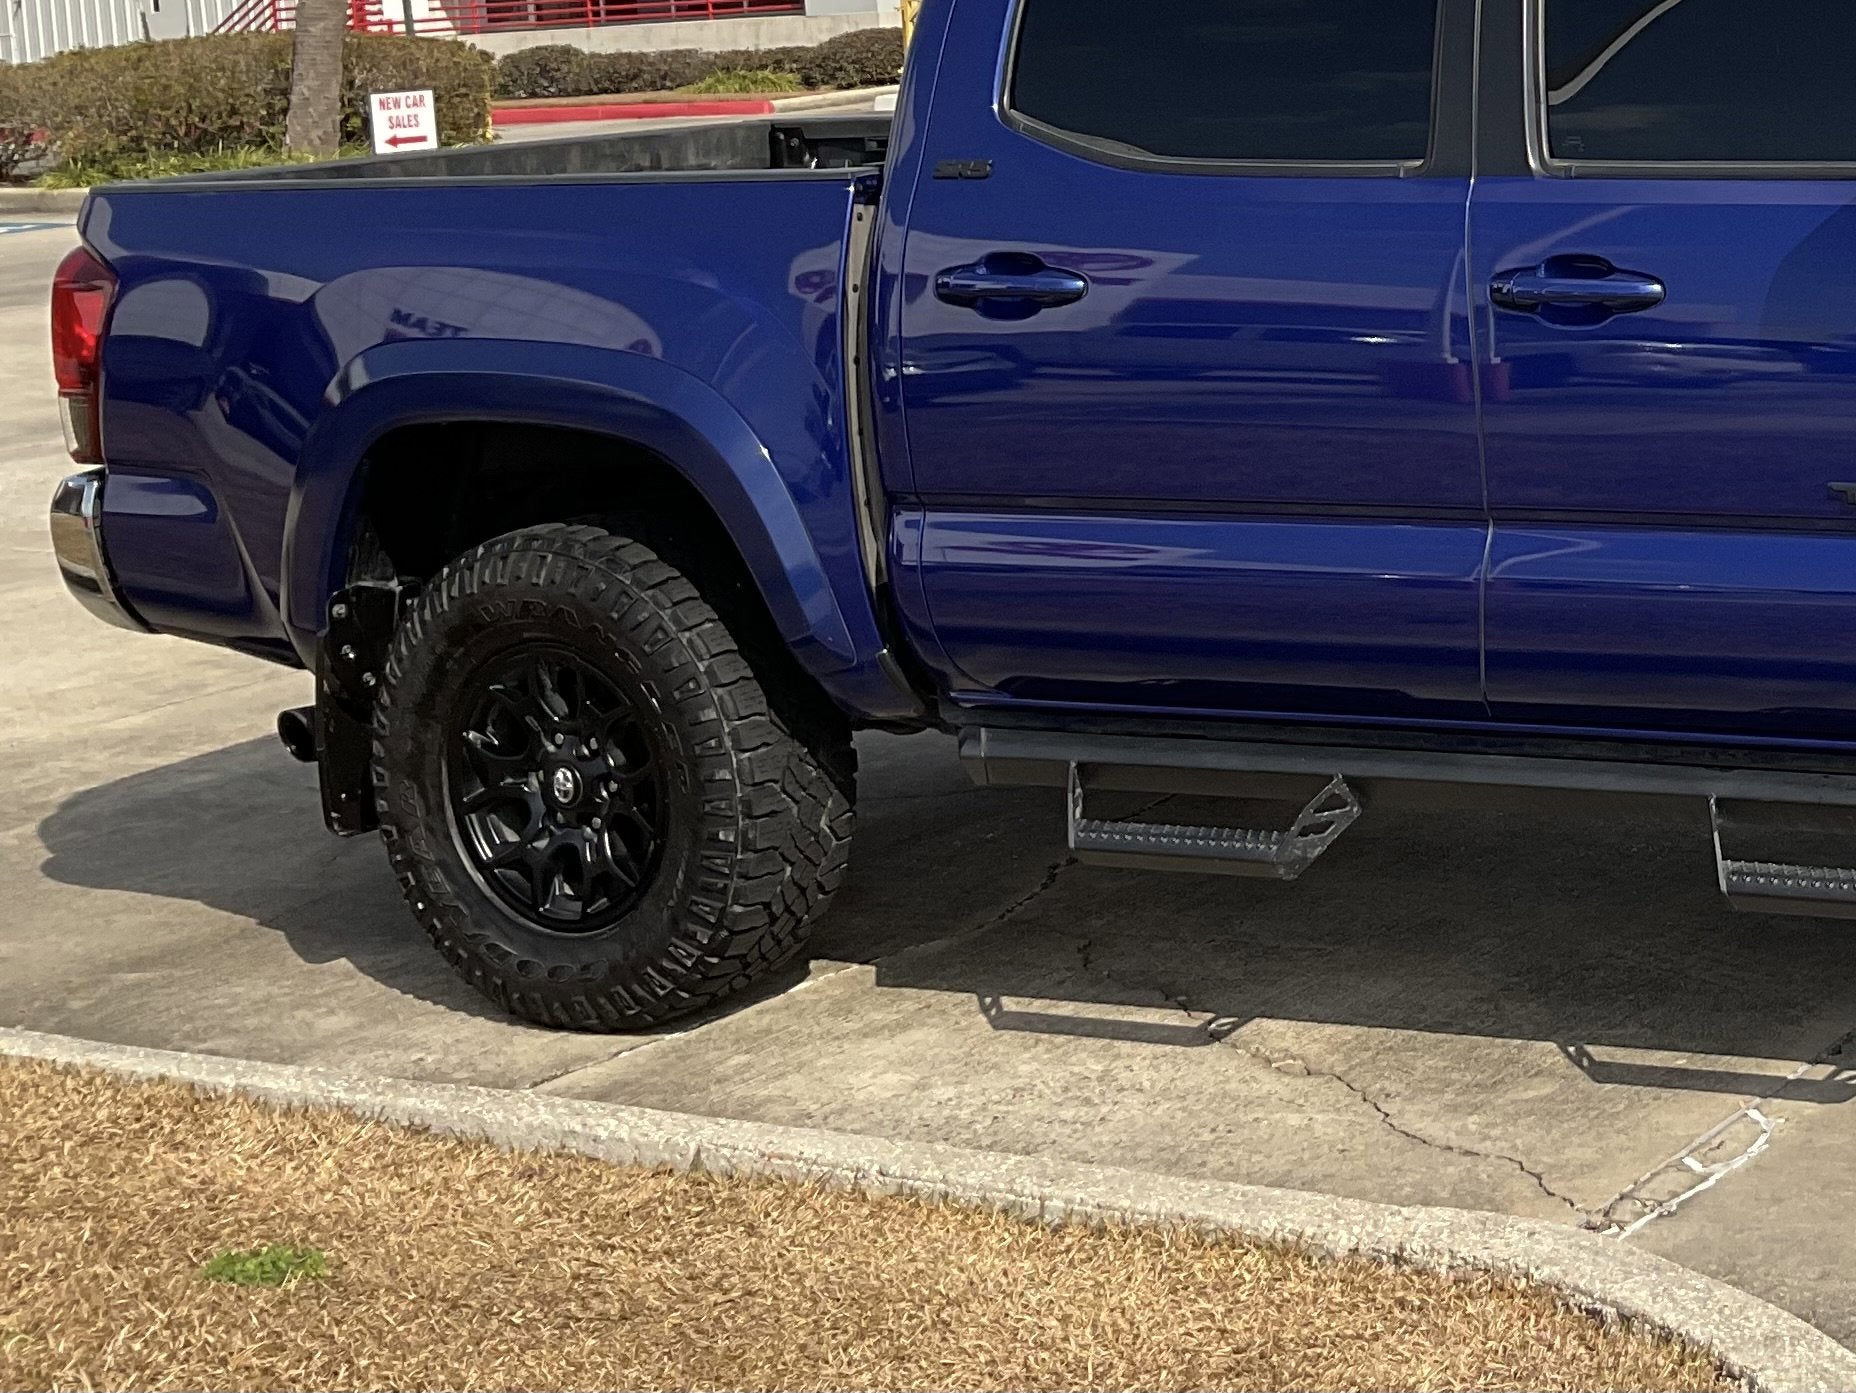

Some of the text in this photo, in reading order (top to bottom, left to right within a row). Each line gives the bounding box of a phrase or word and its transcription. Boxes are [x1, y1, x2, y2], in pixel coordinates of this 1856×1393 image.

[379, 94, 426, 110] NEW CAR
[388, 114, 420, 129] SALES
